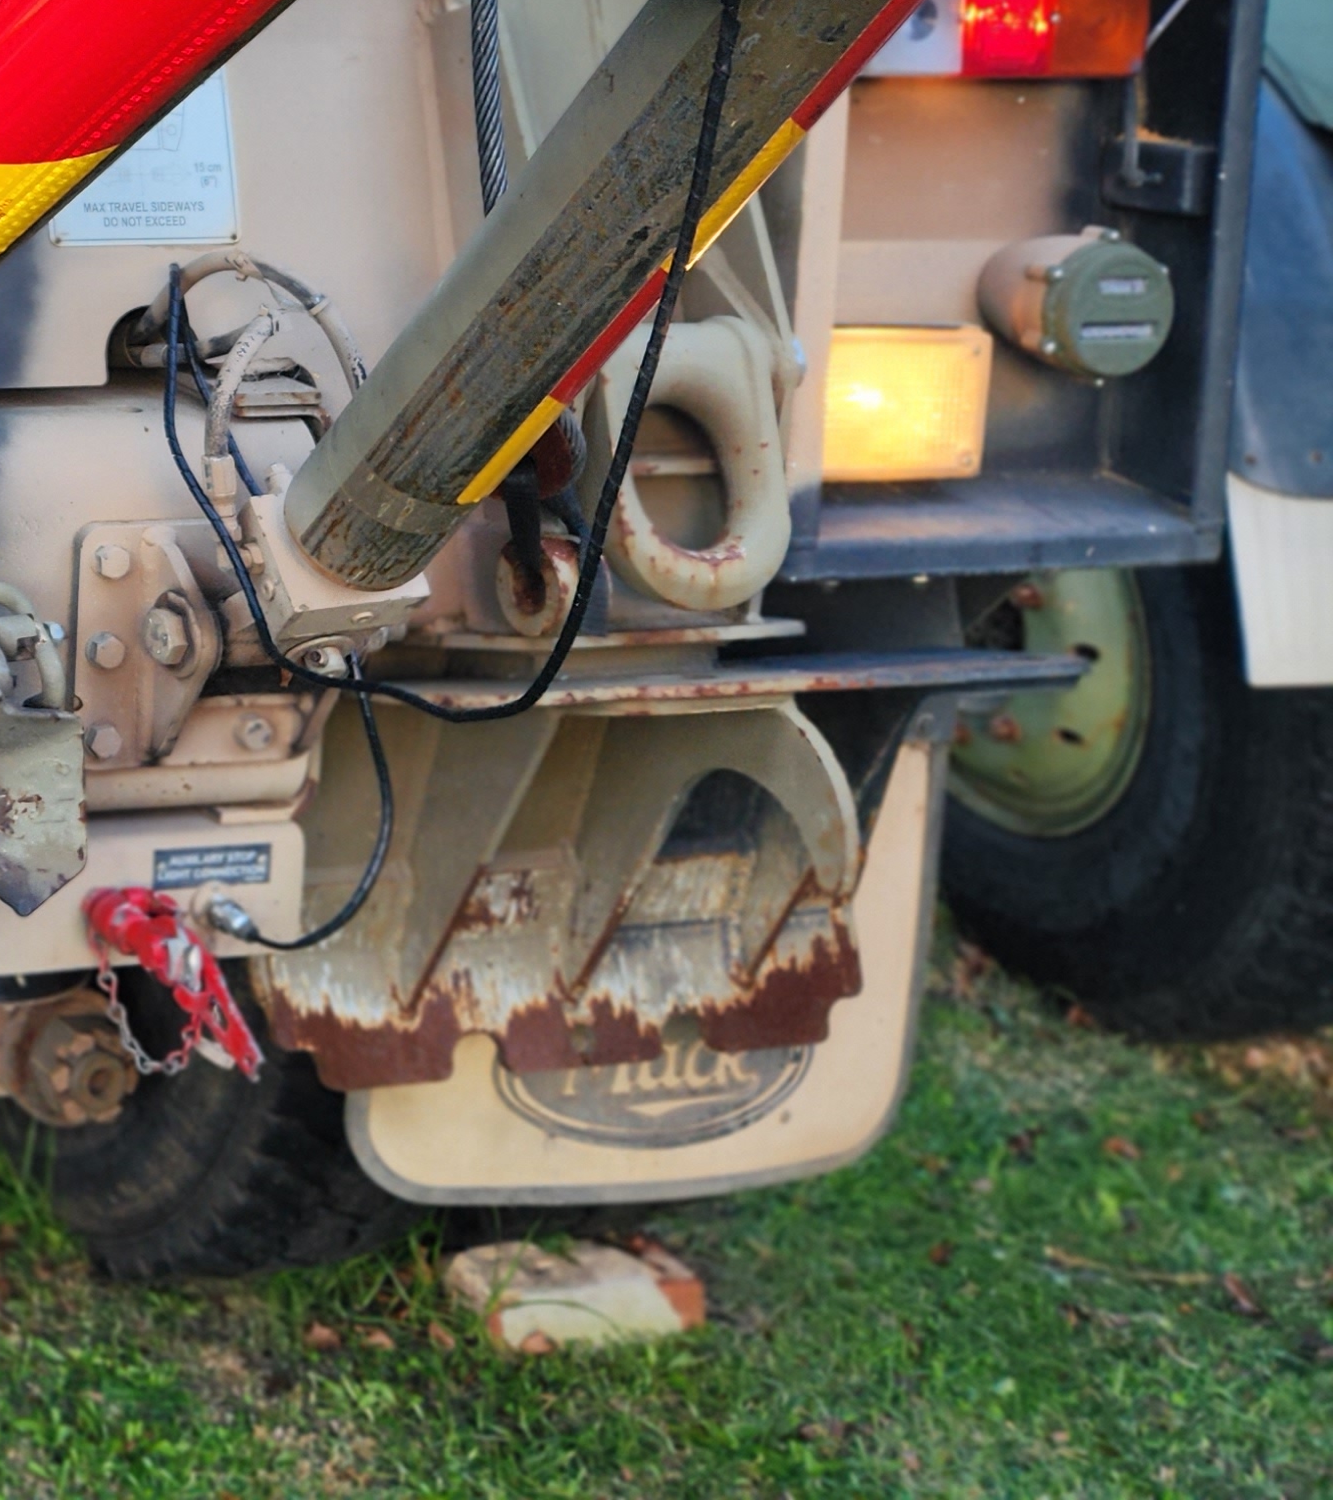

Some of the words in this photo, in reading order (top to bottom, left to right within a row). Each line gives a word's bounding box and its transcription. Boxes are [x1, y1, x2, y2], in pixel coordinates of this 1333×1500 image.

[83, 203, 105, 213] MAX
[108, 202, 148, 212] TRAVEL
[151, 201, 204, 212] SIDEWAYS
[103, 217, 118, 227] DO
[121, 216, 142, 227] NOT
[145, 216, 186, 226] EXCEED
